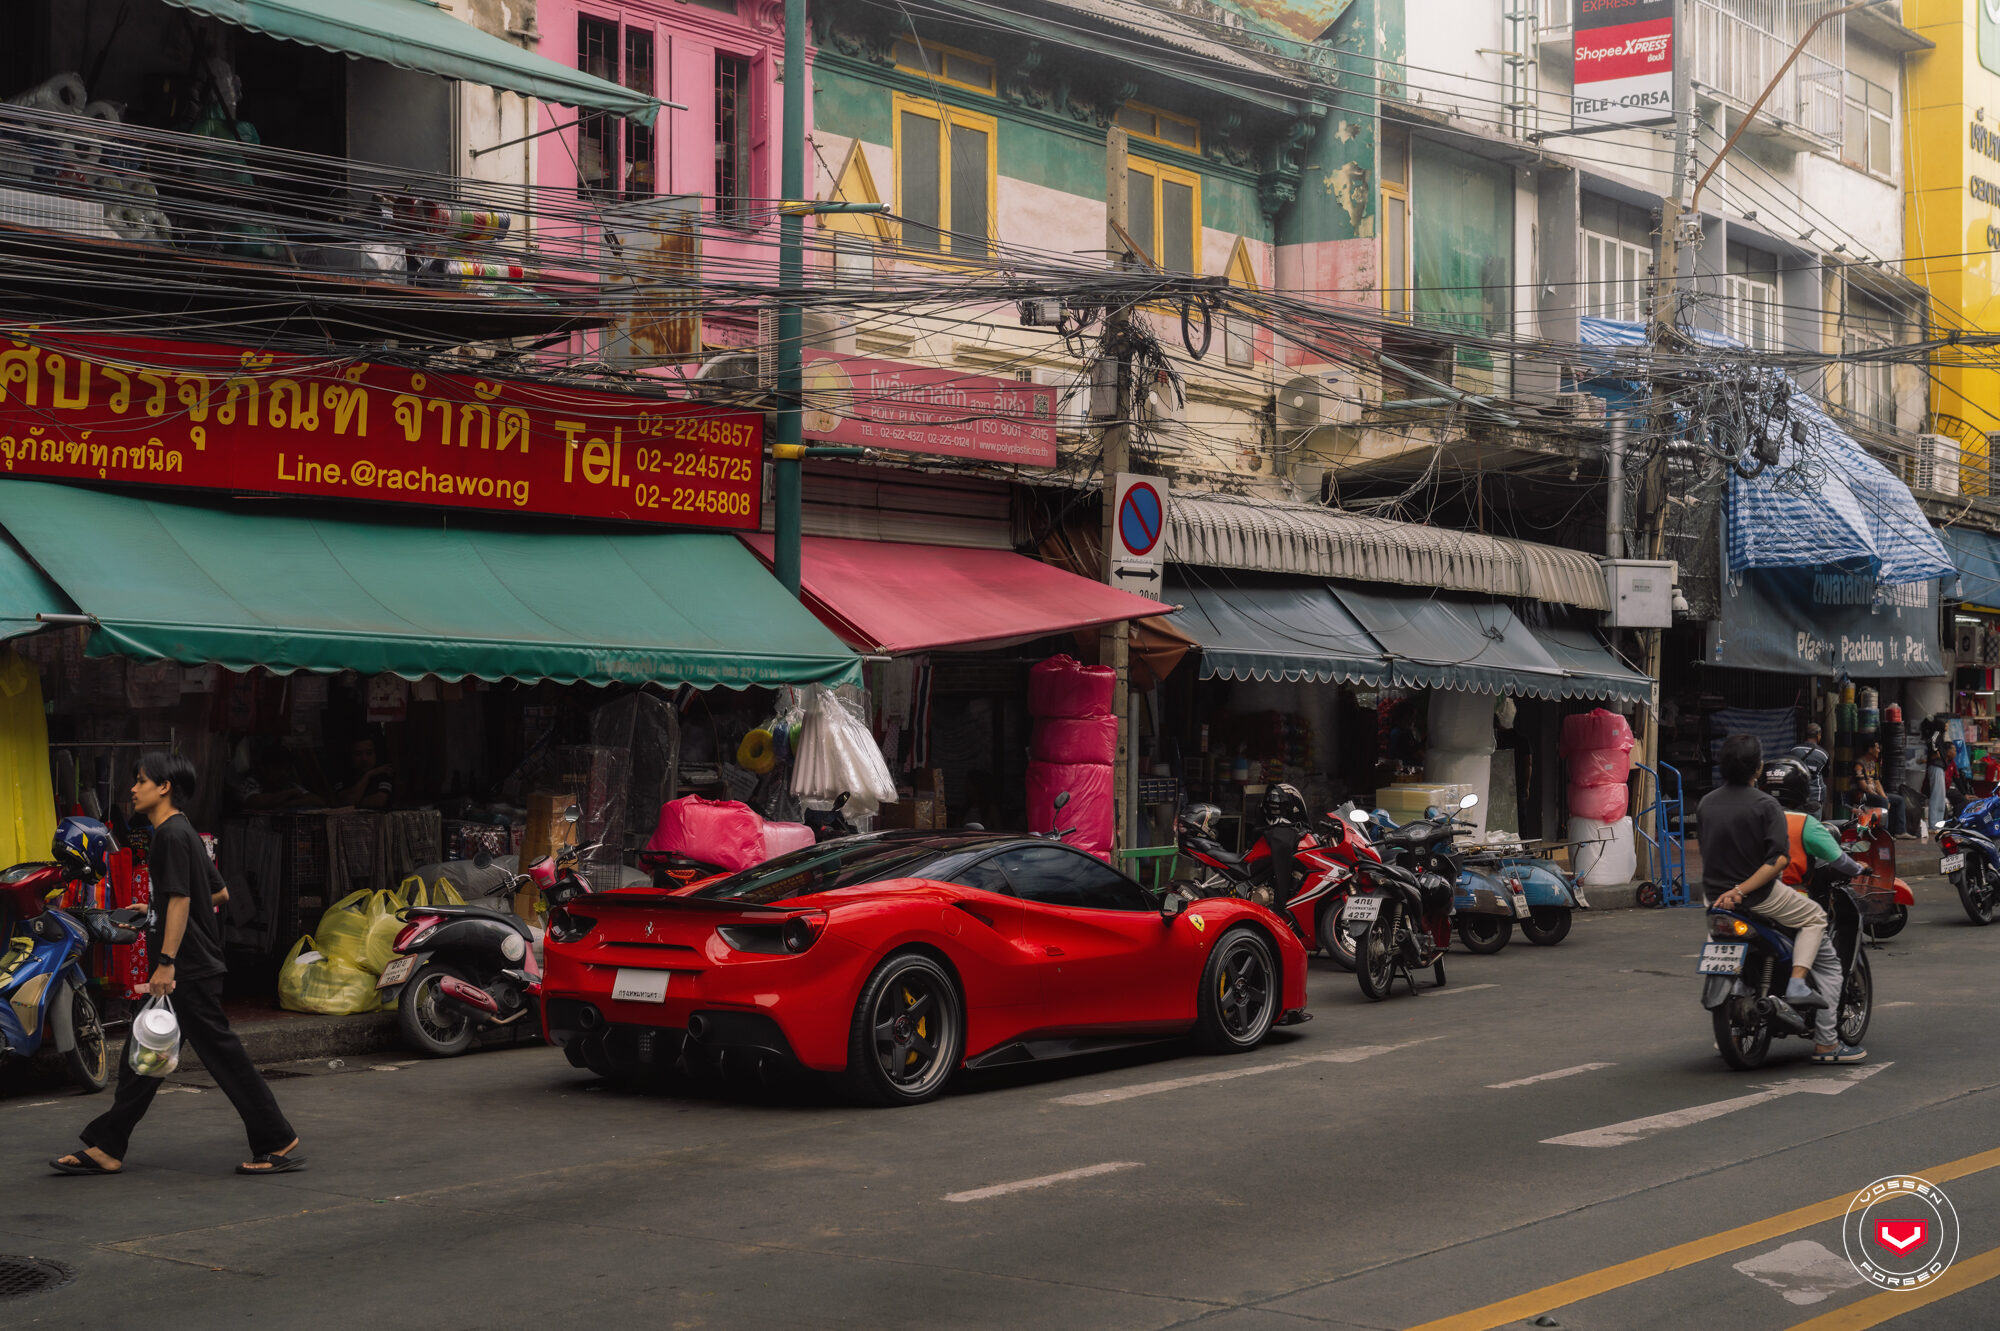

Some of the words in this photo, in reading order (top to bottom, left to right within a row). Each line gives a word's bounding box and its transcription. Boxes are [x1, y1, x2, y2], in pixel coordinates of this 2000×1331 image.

[1575, 46, 1622, 61] Shopee
[1575, 99, 1608, 114] TELE
[1620, 90, 1670, 108] CORSA
[392, 373, 531, 454] จำกัด
[871, 406, 895, 420] POLY
[899, 409, 935, 424] PLASTIC
[982, 421, 998, 434] ISO
[1001, 423, 1021, 437] 9001
[1030, 427, 1049, 441] 2015
[555, 420, 630, 488] Tel.
[638, 411, 754, 448] 02-2245857
[927, 433, 970, 448] 02-225-0124
[277, 453, 530, 506] Line.@rachawong
[636, 447, 752, 482] 02-2245725
[635, 483, 750, 516] 02-2245808
[1841, 633, 1884, 667] Packing
[1347, 911, 1372, 919] 4257
